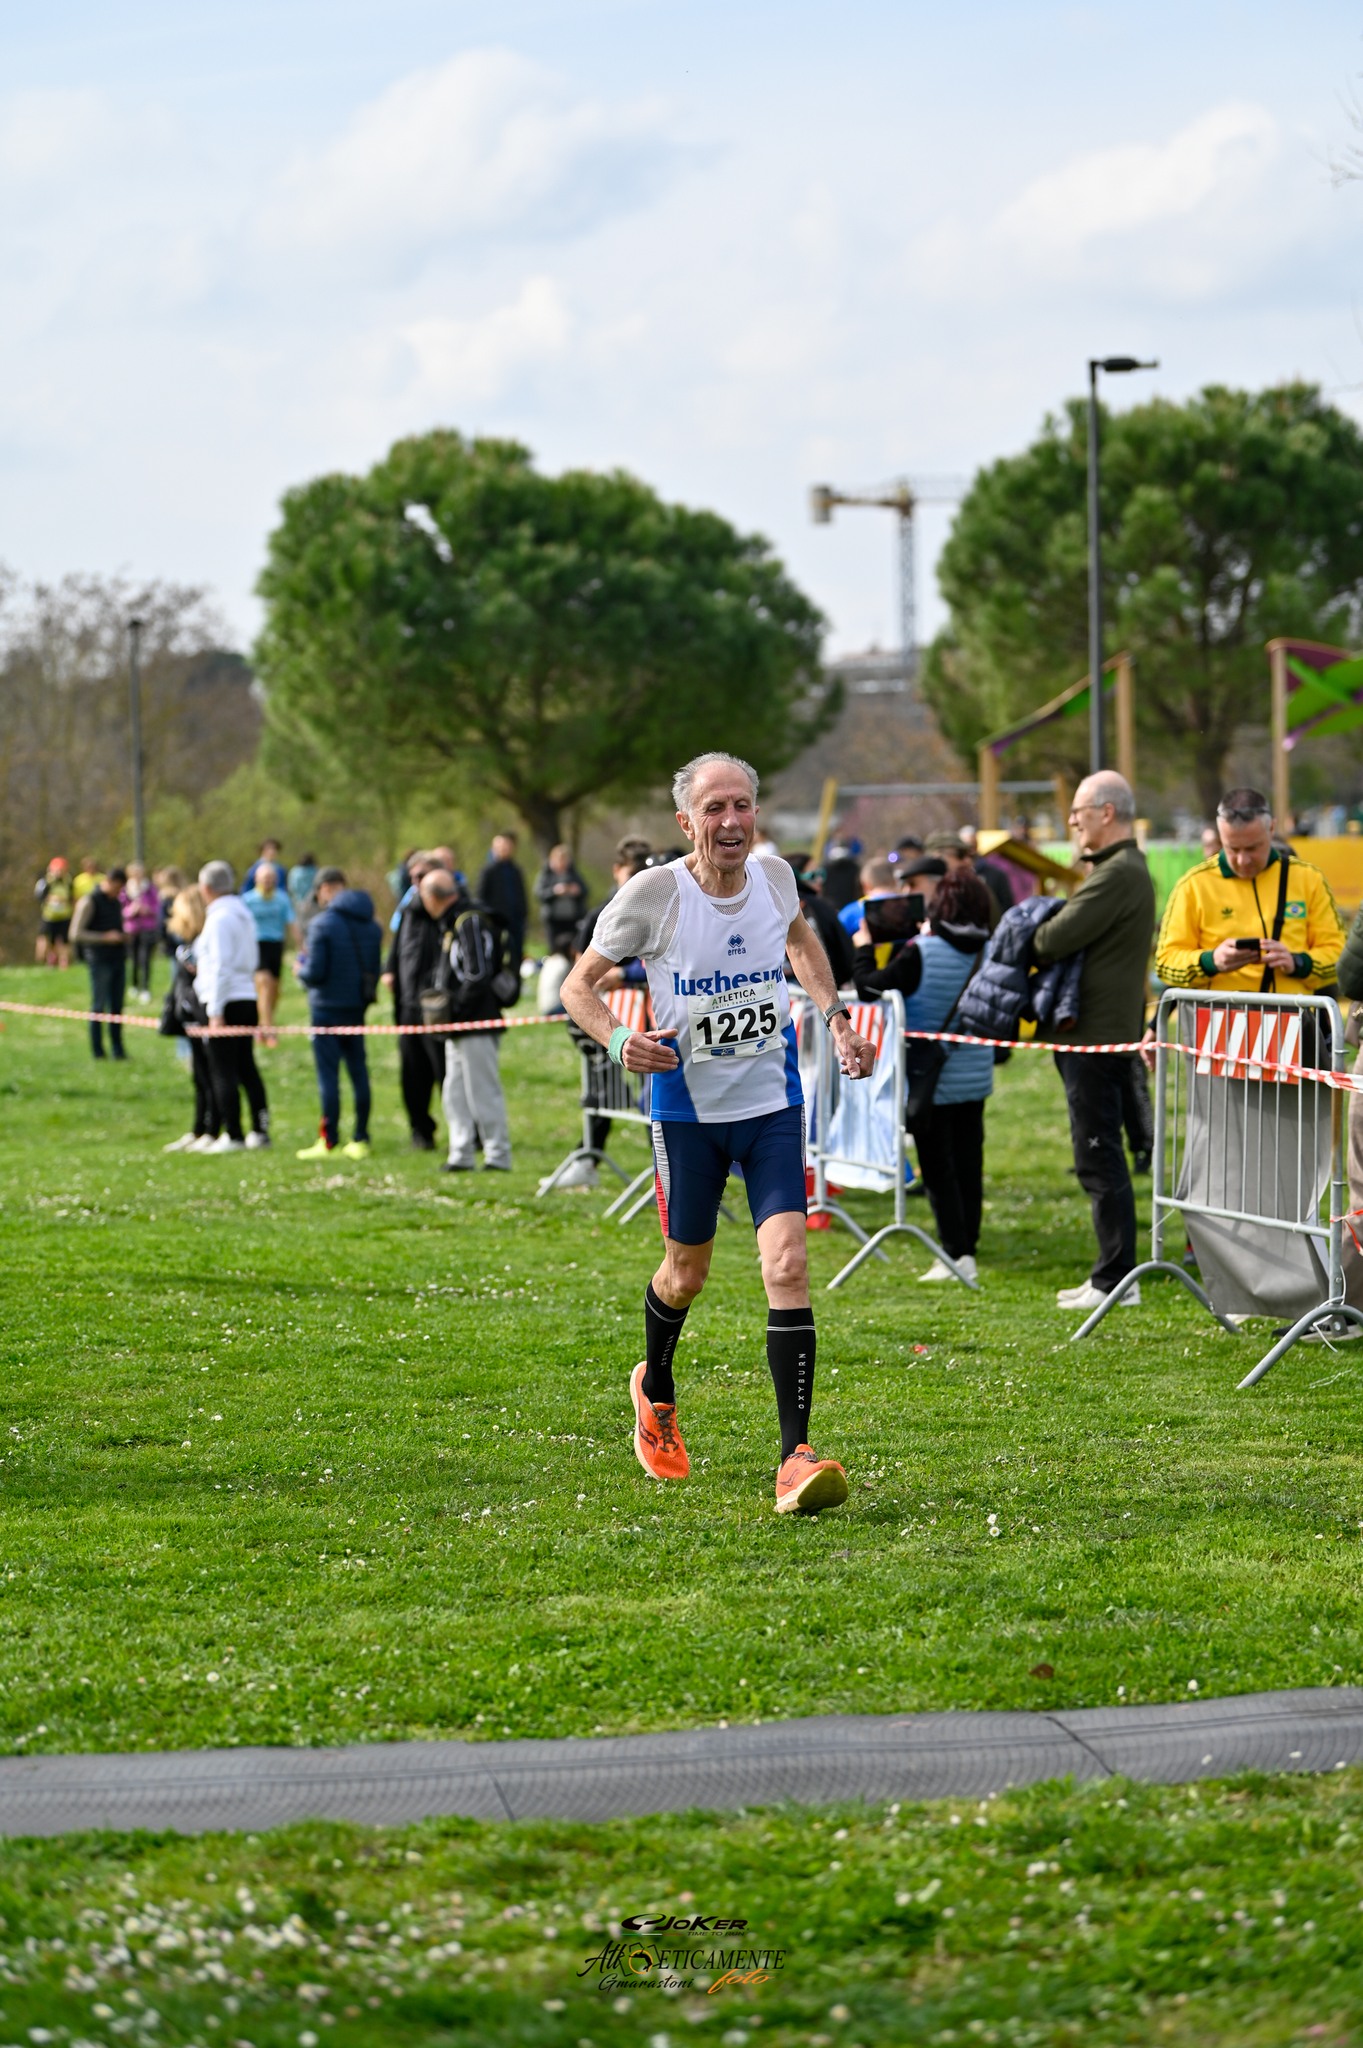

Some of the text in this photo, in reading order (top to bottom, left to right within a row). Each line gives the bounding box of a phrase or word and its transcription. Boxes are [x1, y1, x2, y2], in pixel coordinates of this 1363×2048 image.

[712, 988, 756, 1006] ATLETICA
[696, 1002, 777, 1045] 1225
[798, 1353, 806, 1410] OXYBURN
